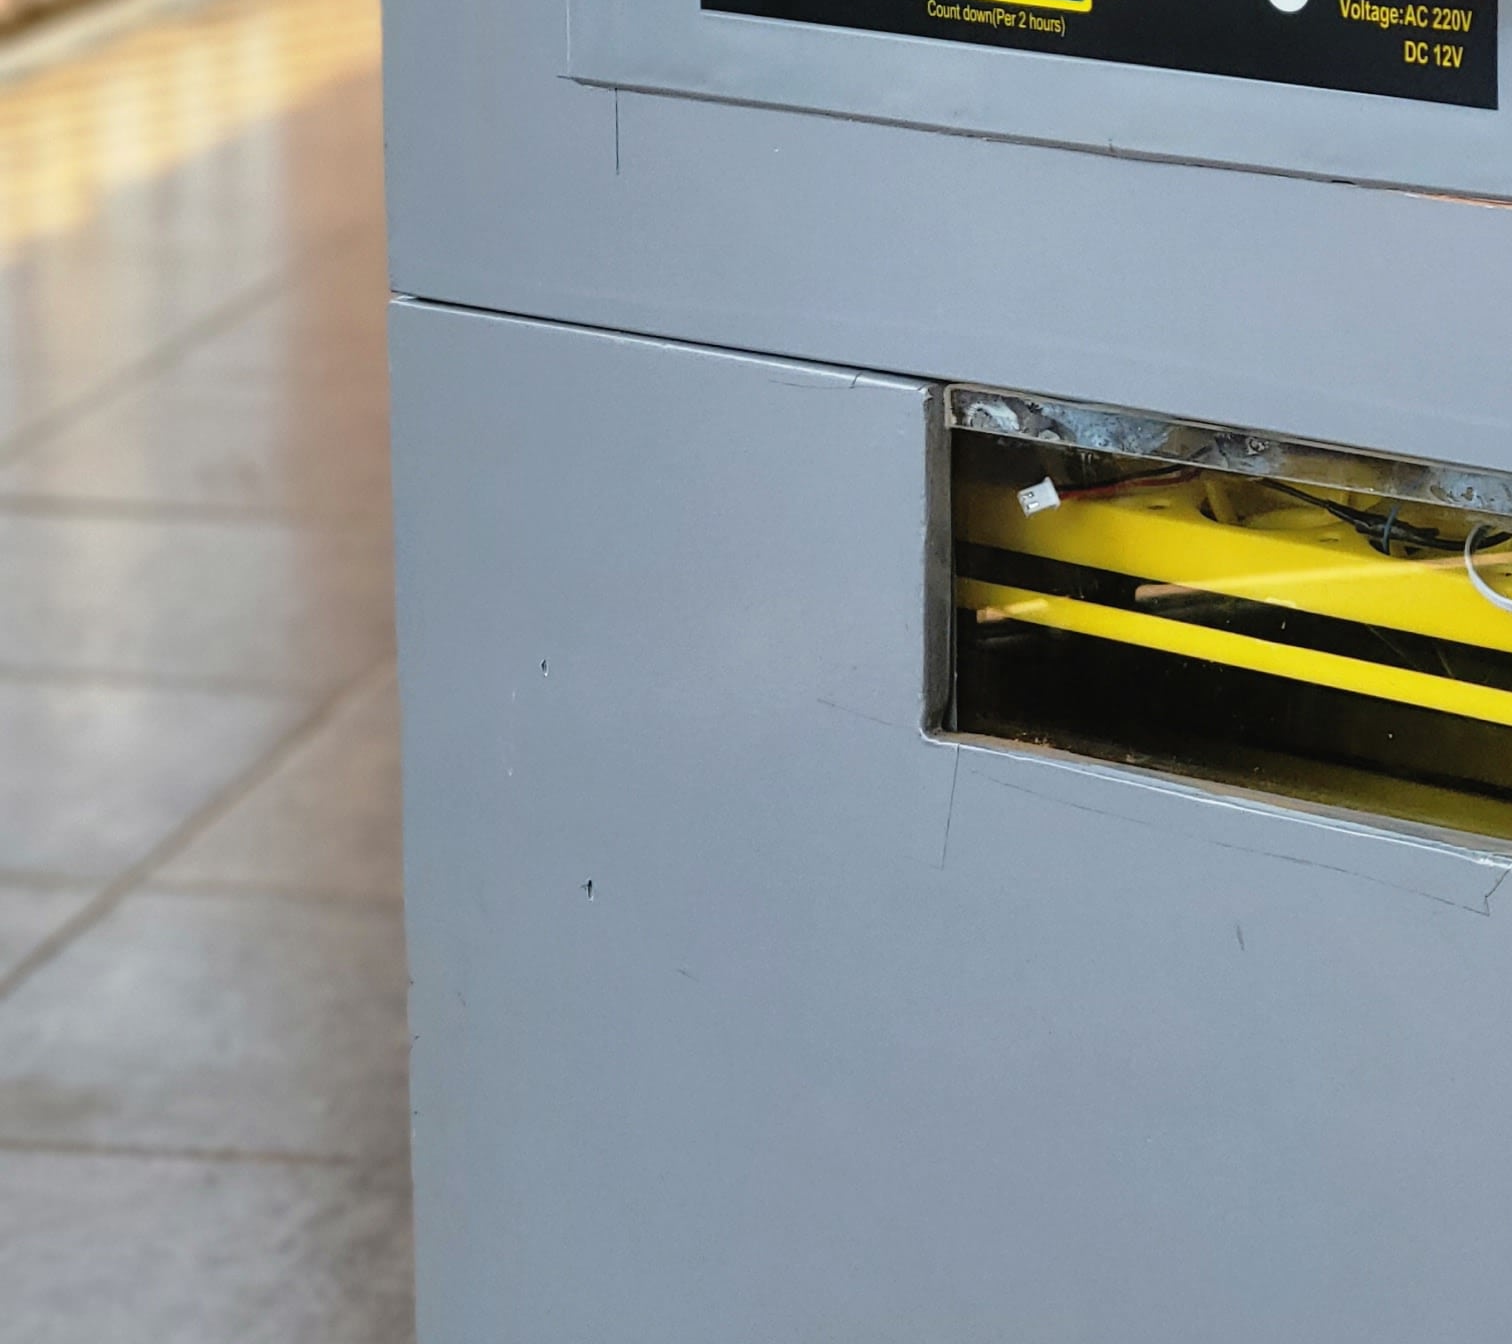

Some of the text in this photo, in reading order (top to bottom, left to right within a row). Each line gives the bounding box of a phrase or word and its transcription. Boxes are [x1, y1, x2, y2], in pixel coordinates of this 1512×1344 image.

[927, 0, 961, 20] Count
[1018, 11, 1027, 29] 2
[1029, 16, 1066, 37] hours)
[1432, 7, 1473, 33] 220V
[1404, 40, 1463, 68] DC 12V
